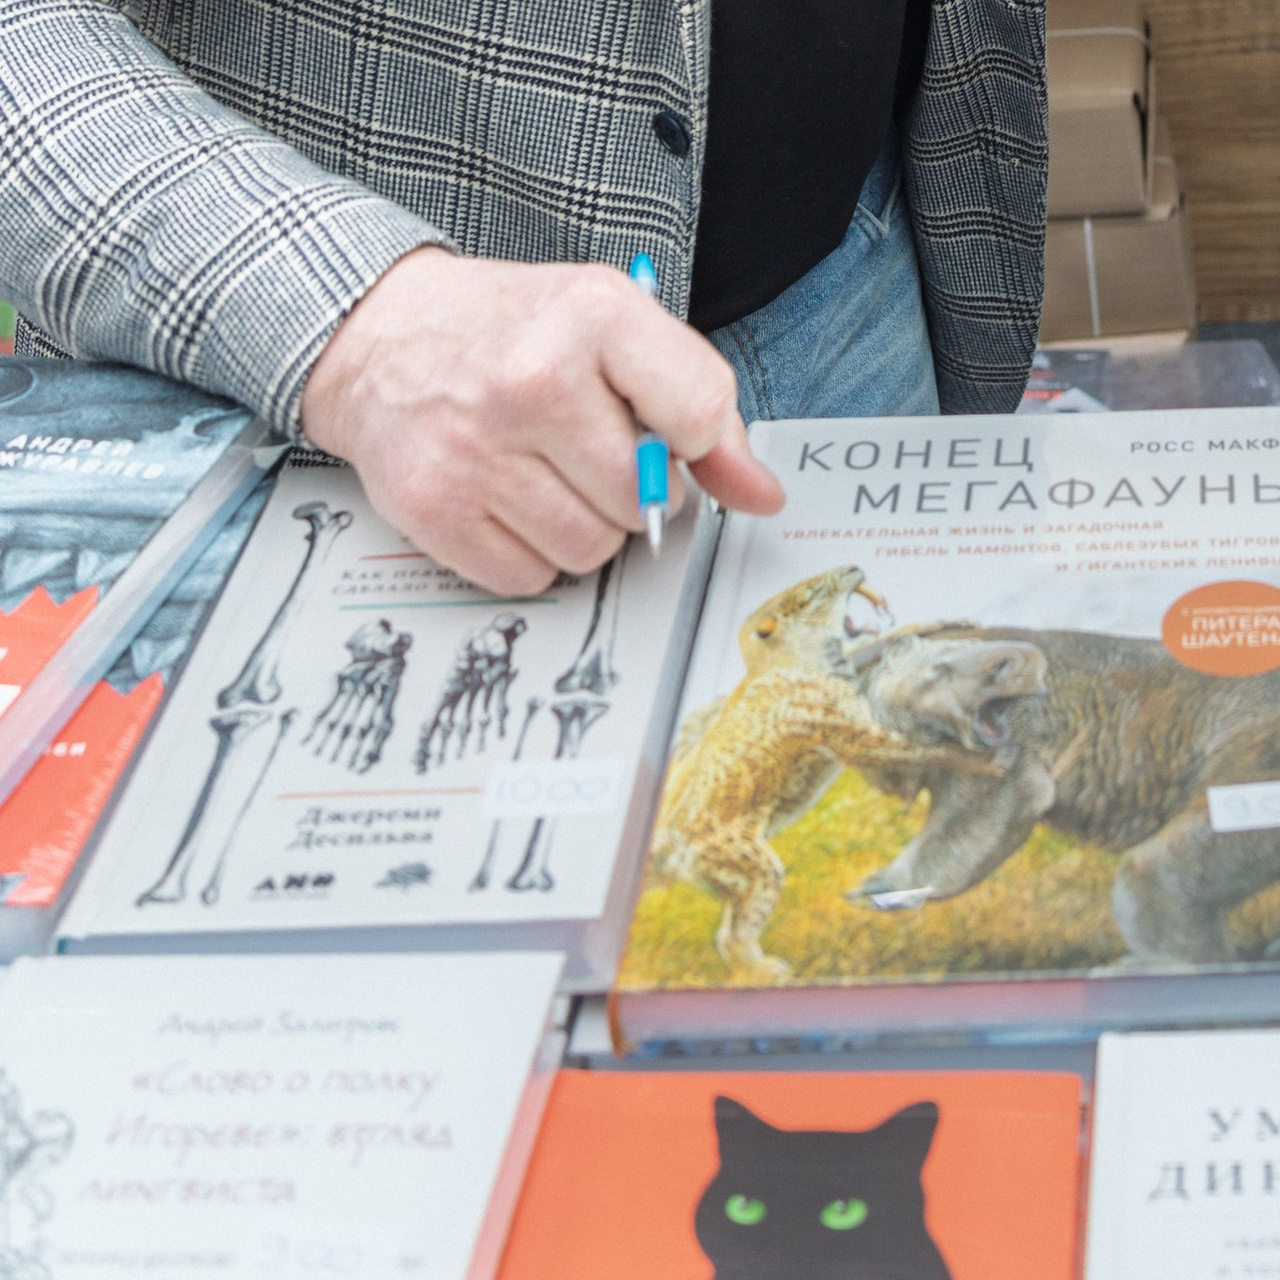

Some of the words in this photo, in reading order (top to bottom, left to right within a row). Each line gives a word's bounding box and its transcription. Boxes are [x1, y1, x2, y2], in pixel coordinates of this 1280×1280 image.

[798, 437, 1034, 473] КОНЕЦ
[1130, 440, 1195, 454] РОСС
[783, 526, 940, 540] УВЛЕКАТЕЛЬНАЯ
[949, 525, 1015, 536] ЖИЗНЬ
[1044, 519, 1165, 535] ЗАГАДОЧНАЯ
[875, 545, 950, 558] ГИБЕЛЬ
[1075, 538, 1200, 553] САБЛЕЗУБЫХ
[1209, 536, 1280, 549] ТИГРОВ
[1076, 559, 1197, 572] ГИГАНТСКИХ
[295, 806, 441, 827] Джереми
[321, 1069, 443, 1115] полку
